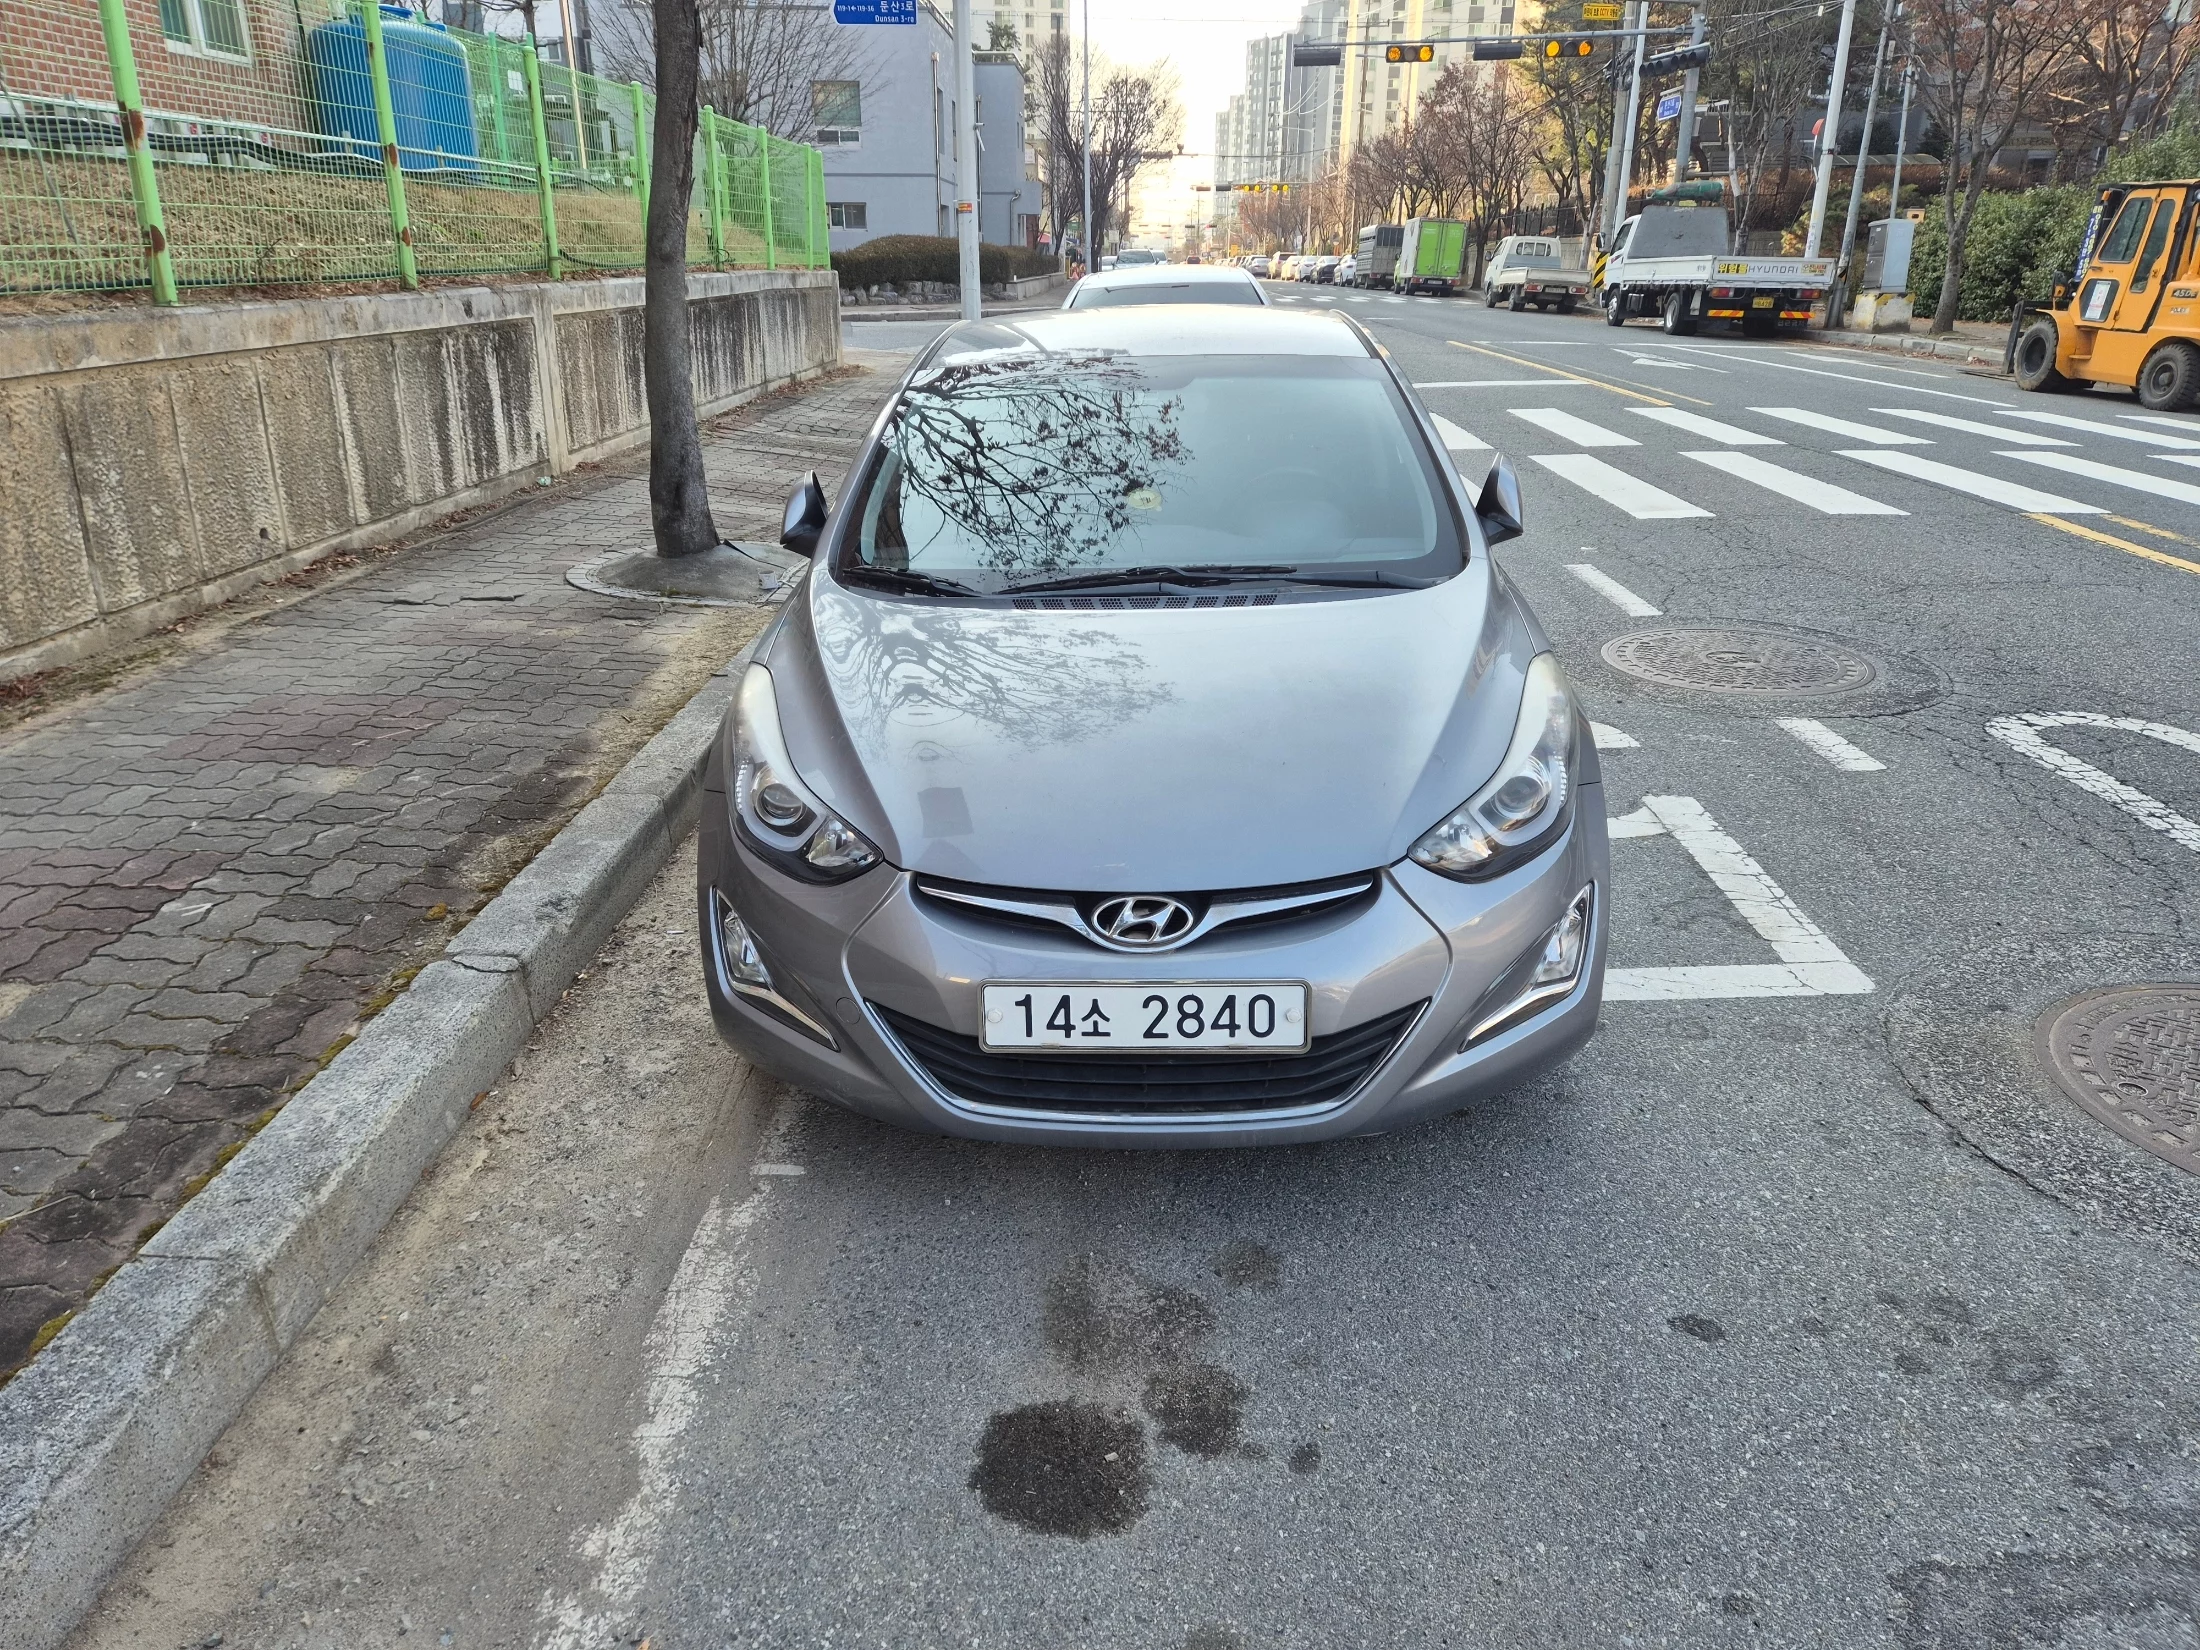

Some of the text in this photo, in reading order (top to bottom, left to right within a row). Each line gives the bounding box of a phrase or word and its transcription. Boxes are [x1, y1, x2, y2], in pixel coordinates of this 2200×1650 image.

[880, 1, 914, 13] 둔산3로
[901, 15, 915, 23] 3-ro
[1749, 265, 1799, 274] HYUNDAI
[1014, 993, 1276, 1039] 14소 2840
